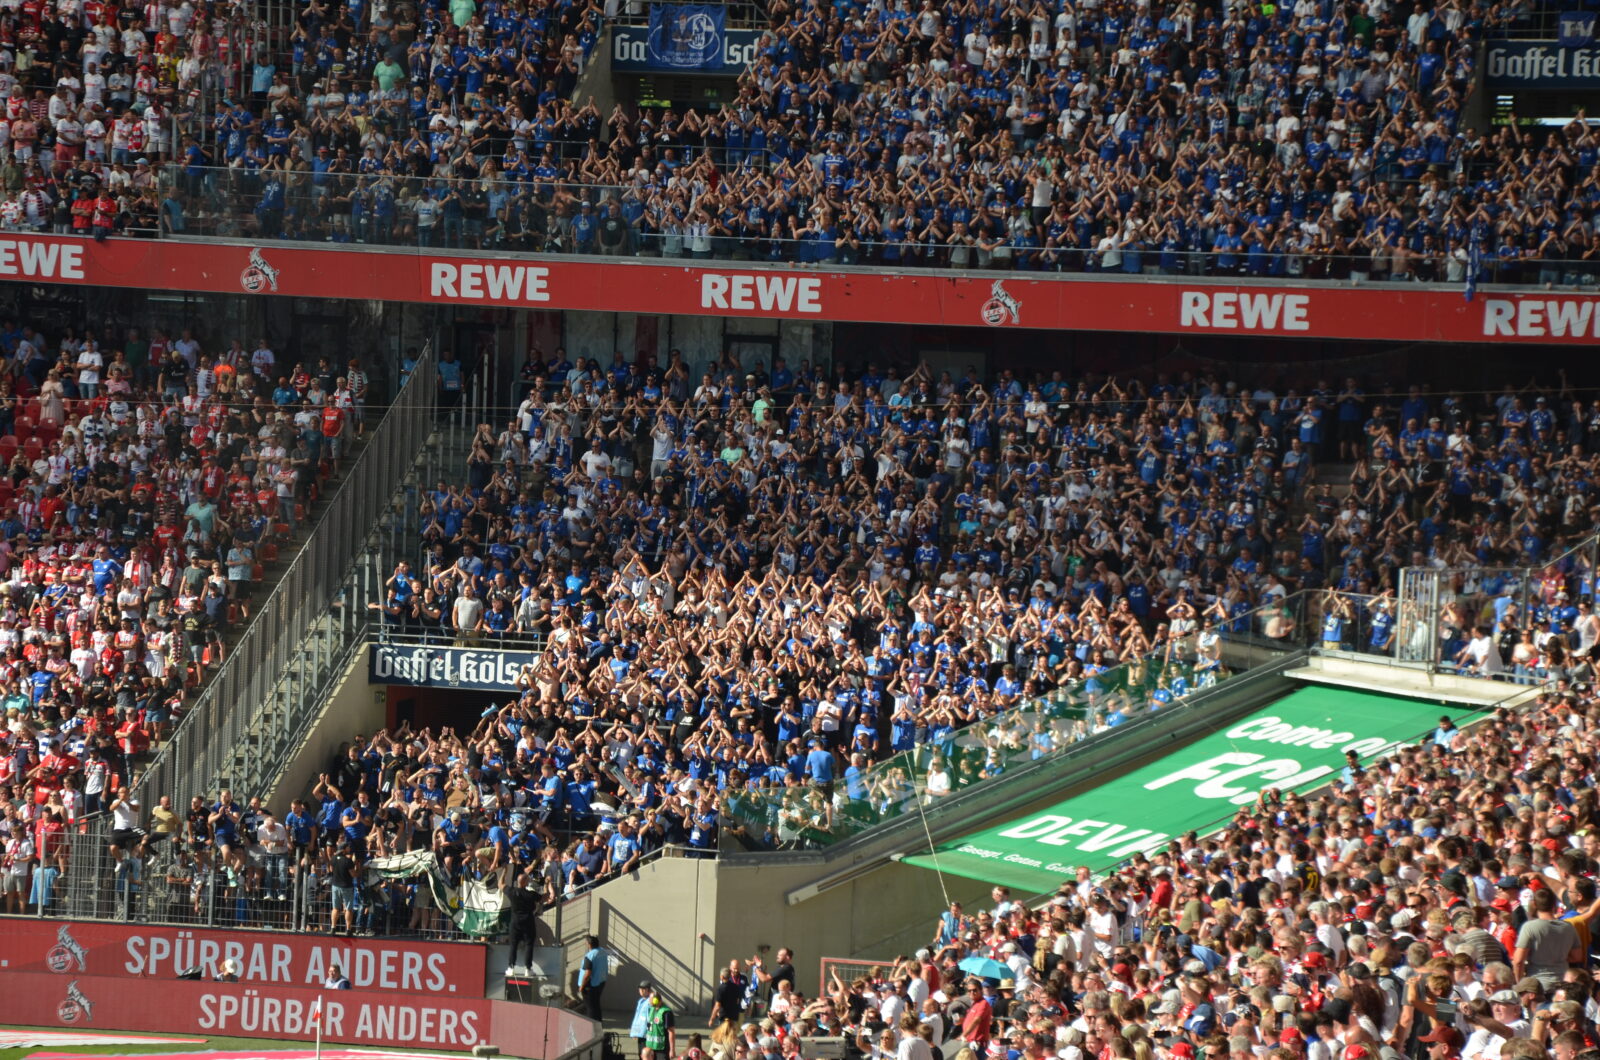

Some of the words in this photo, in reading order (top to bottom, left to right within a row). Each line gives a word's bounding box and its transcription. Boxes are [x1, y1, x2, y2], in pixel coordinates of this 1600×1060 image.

[1488, 47, 1567, 80] Gaffel
[0, 240, 84, 279] EWE
[431, 262, 550, 301] REWE
[702, 273, 822, 312] REWE
[1180, 291, 1310, 331] REWE
[1483, 299, 1600, 338] REW
[375, 648, 453, 684] Gaffel
[1226, 716, 1354, 749] Come
[125, 931, 292, 983] SPÜRBAR
[305, 946, 456, 992] ANDERS.
[198, 989, 344, 1037] SPÜRBAR
[355, 1003, 486, 1046] ANDERS.
